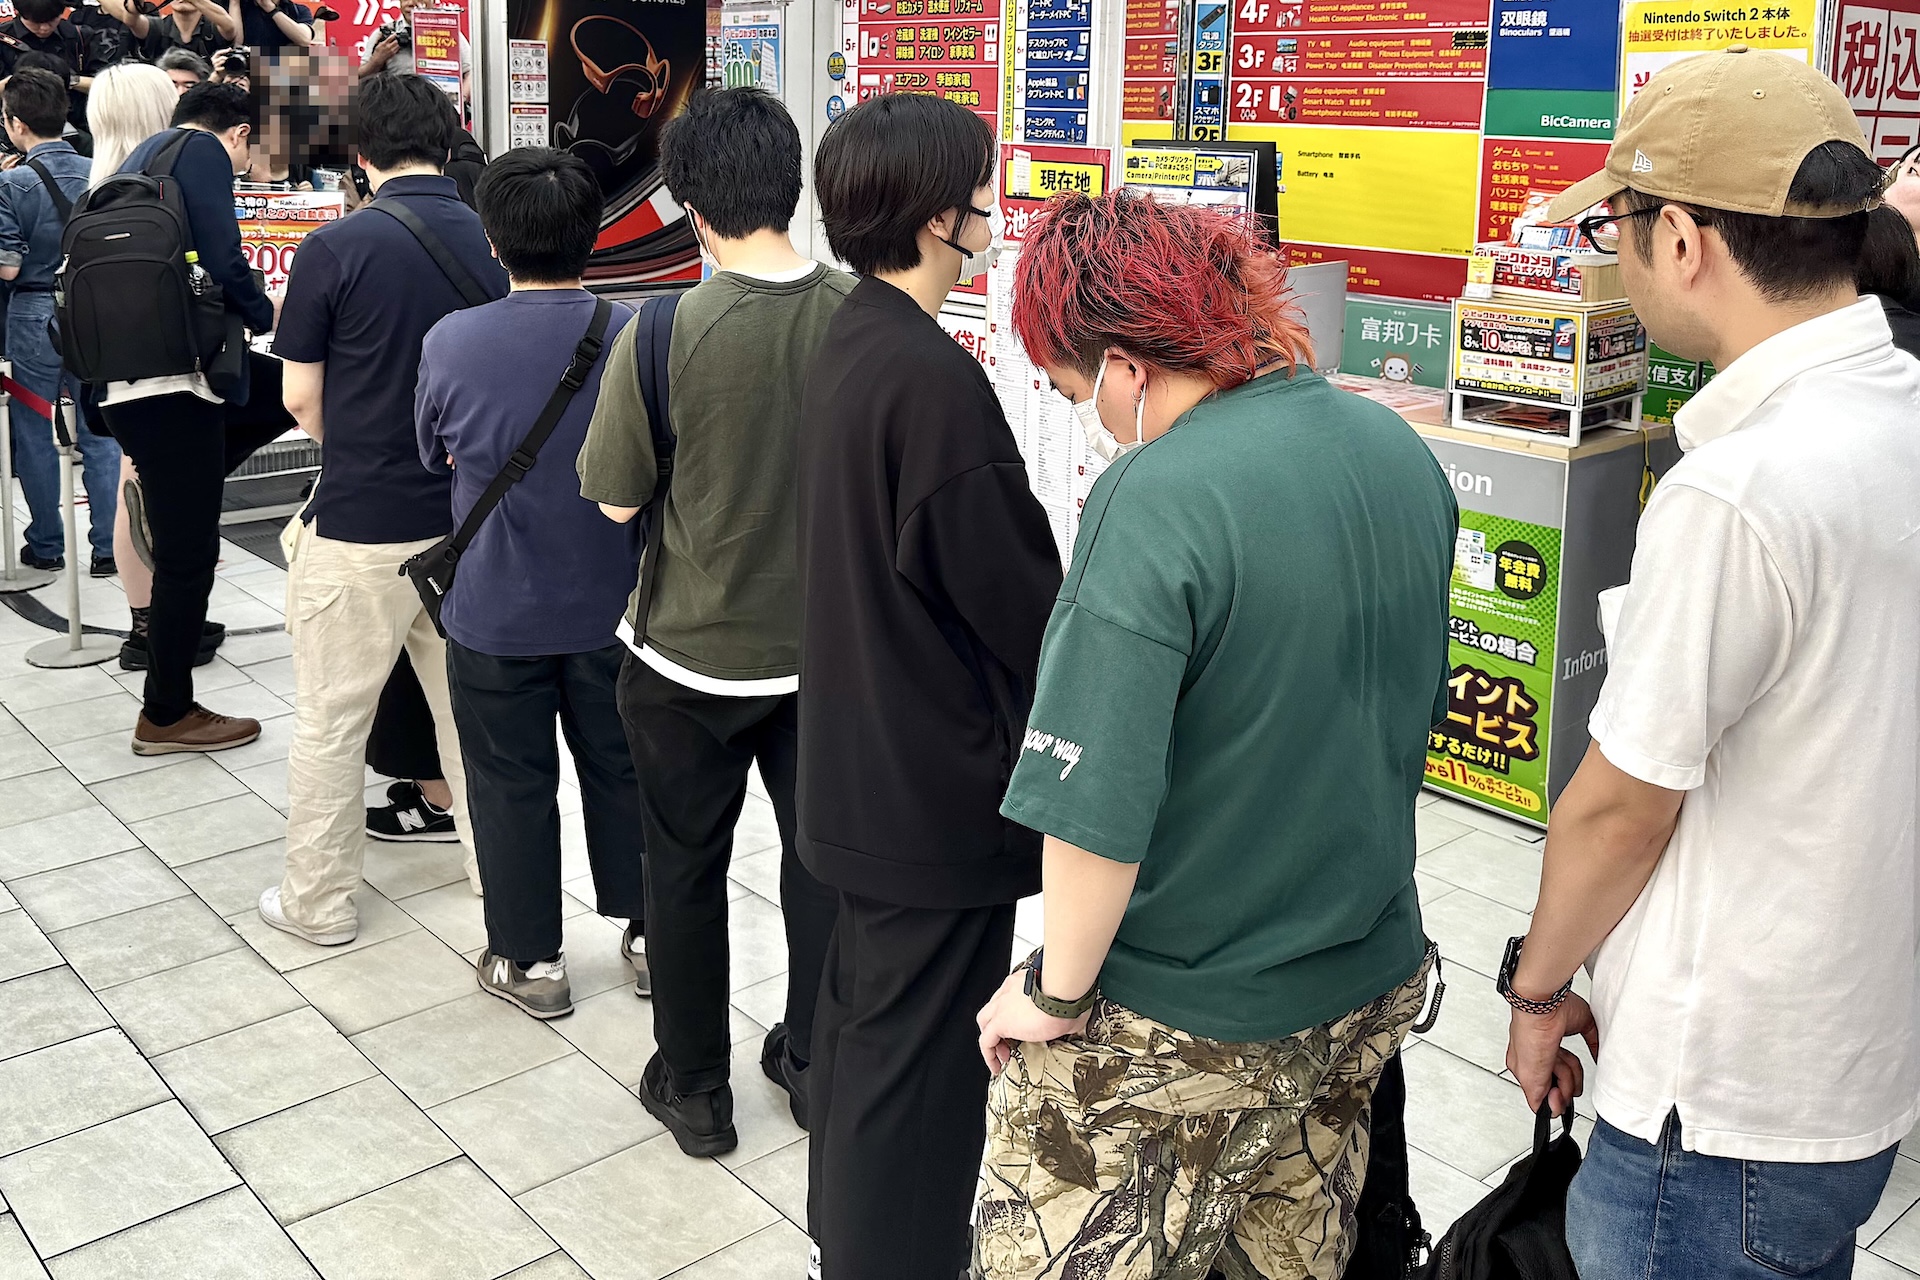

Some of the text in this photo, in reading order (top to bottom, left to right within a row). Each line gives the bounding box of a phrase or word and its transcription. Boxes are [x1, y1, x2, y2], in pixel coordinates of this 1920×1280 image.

[955, 0, 983, 13] リフォーム
[1240, 0, 1270, 24] 4F
[1309, 3, 1375, 13] Seasonal appliances
[1308, 12, 1398, 23] Health Consumer Electronic
[1500, 10, 1548, 27] 双眼鏡
[1643, 8, 1791, 25] Nintendo Switch 2 本体
[895, 28, 915, 42] 冷蔵庫
[944, 28, 982, 41] ワインセラー
[1202, 31, 1219, 40] 電源
[1500, 28, 1543, 37] Binoculars
[1628, 25, 1808, 43] 抽選受付は終了いたしました。
[845, 39, 856, 51] 5F
[1028, 38, 1068, 48] デスクトップPC
[1197, 41, 1223, 49] タップ
[1348, 40, 1368, 48] Audio
[1368, 40, 1405, 49] equipment
[919, 46, 944, 59] アイロン
[1238, 44, 1265, 69] 3F
[1306, 51, 1324, 59] Home
[1324, 50, 1346, 59] theater
[1379, 50, 1401, 59] Fitness
[1401, 50, 1434, 59] Equipment
[1197, 52, 1222, 71] 3F
[1305, 62, 1324, 70] Power
[1325, 62, 1337, 70] Tap
[1368, 62, 1393, 70] Disaster
[1393, 62, 1428, 70] Prevention
[1428, 61, 1454, 70] Product
[1841, 20, 1920, 100] 税込
[895, 73, 971, 87] エアコン 季節家電
[844, 82, 856, 94] 4F
[1027, 90, 1064, 98] タブレットPC
[1303, 87, 1322, 95] Audio
[1323, 87, 1358, 96] equipment
[1236, 83, 1263, 109] 2F
[1302, 98, 1345, 106] Smart Watch
[1195, 106, 1219, 115] スマホ
[1302, 108, 1380, 118] Smartphone accessories
[1026, 117, 1056, 127] ゲーミングPC
[1193, 115, 1220, 123] アクセサリー
[1541, 115, 1611, 129] BicCamera
[1194, 126, 1220, 141] 2F
[1298, 150, 1334, 159] Smartphone
[1493, 146, 1522, 158] ゲーム
[1492, 160, 1530, 171] おもちゃ
[1126, 171, 1191, 183] Camera/Printer/PC
[1297, 170, 1319, 179] Battery
[1491, 174, 1529, 186] 生活家電
[1040, 169, 1091, 193] 現在地
[1490, 187, 1527, 199] パソコン
[1291, 249, 1307, 259] Drug
[1490, 249, 1552, 267] ビックカメラ
[1483, 357, 1513, 368] 送料無料
[1498, 556, 1541, 580] 年会費
[1504, 572, 1533, 593] 無料
[1480, 632, 1537, 665] の場合
[1448, 670, 1532, 716] イント
[1051, 737, 1085, 782] way
[492, 960, 509, 984] N
